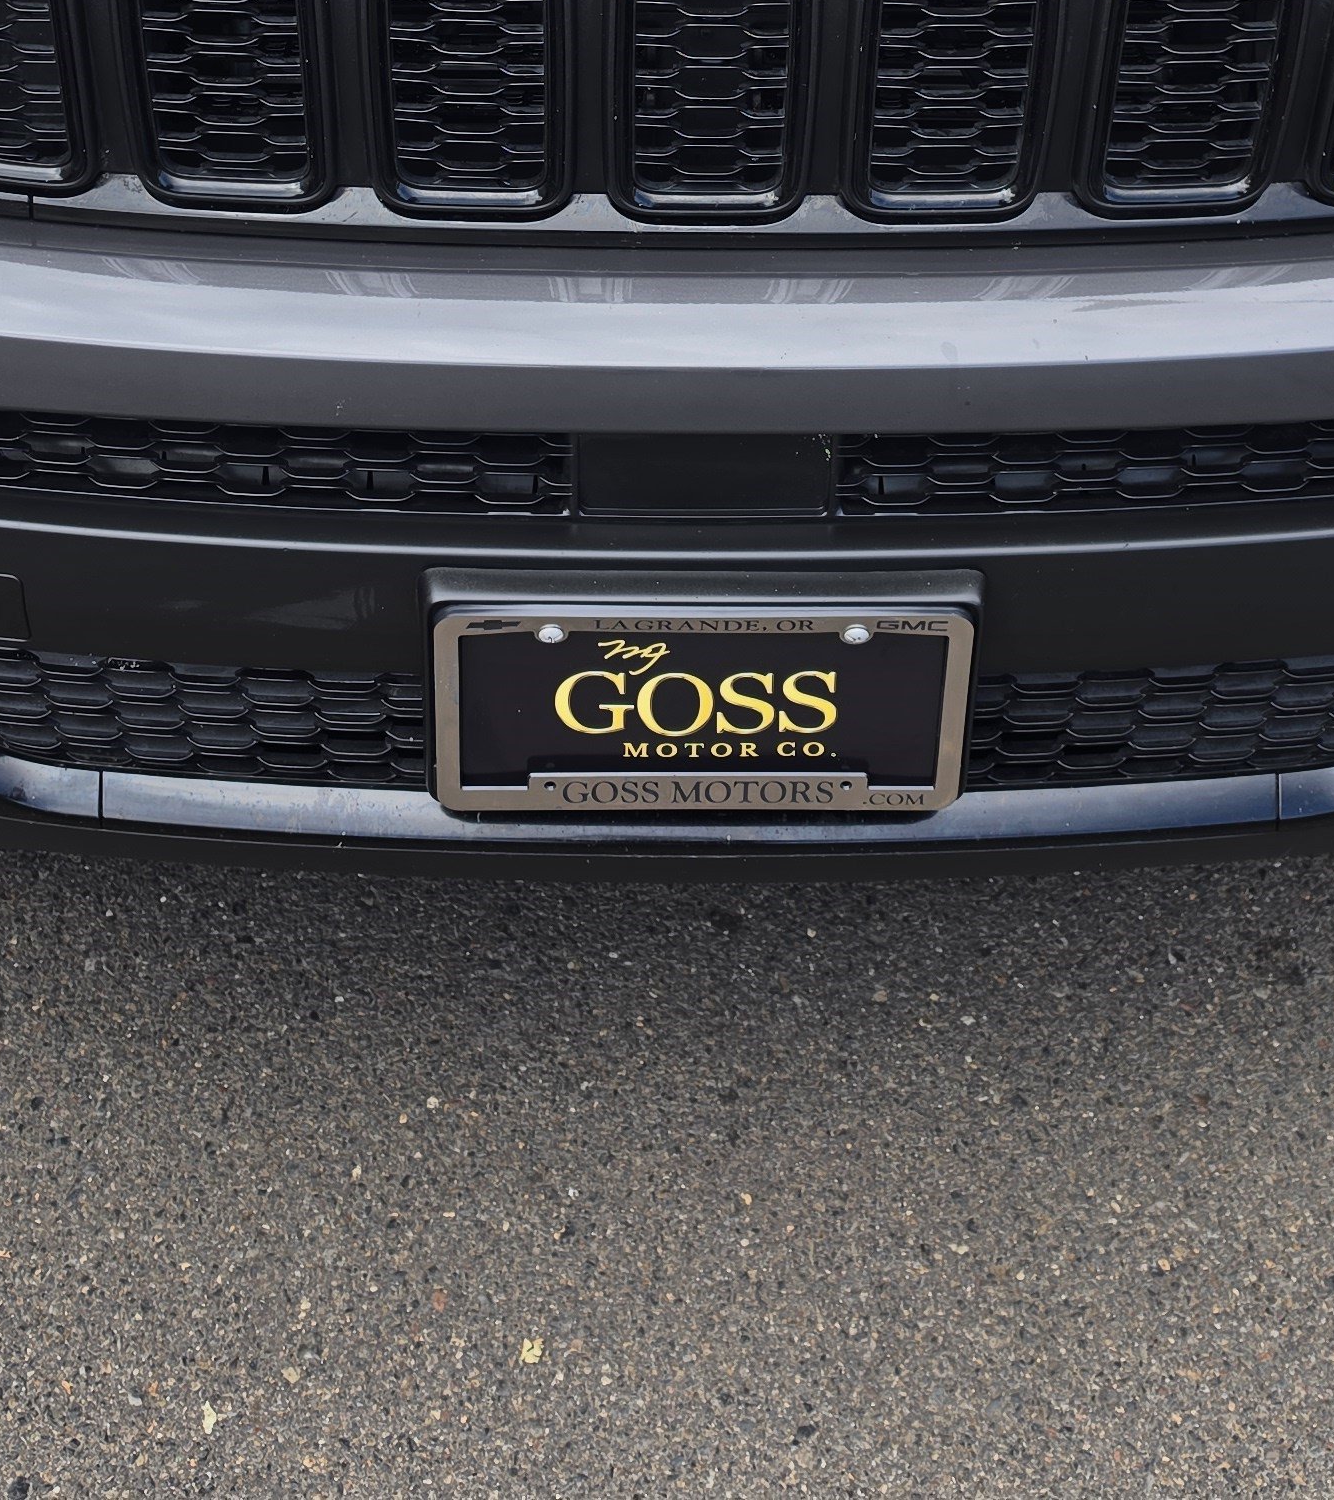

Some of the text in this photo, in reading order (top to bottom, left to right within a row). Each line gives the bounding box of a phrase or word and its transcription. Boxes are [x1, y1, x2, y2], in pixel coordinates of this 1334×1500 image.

[776, 619, 815, 632] OR
[875, 620, 949, 632] GMC
[554, 670, 838, 737] GOSS
[622, 741, 837, 758] MOTOR CO.
[562, 780, 835, 804] GOSS MOTORS
[862, 793, 925, 806] .COM
